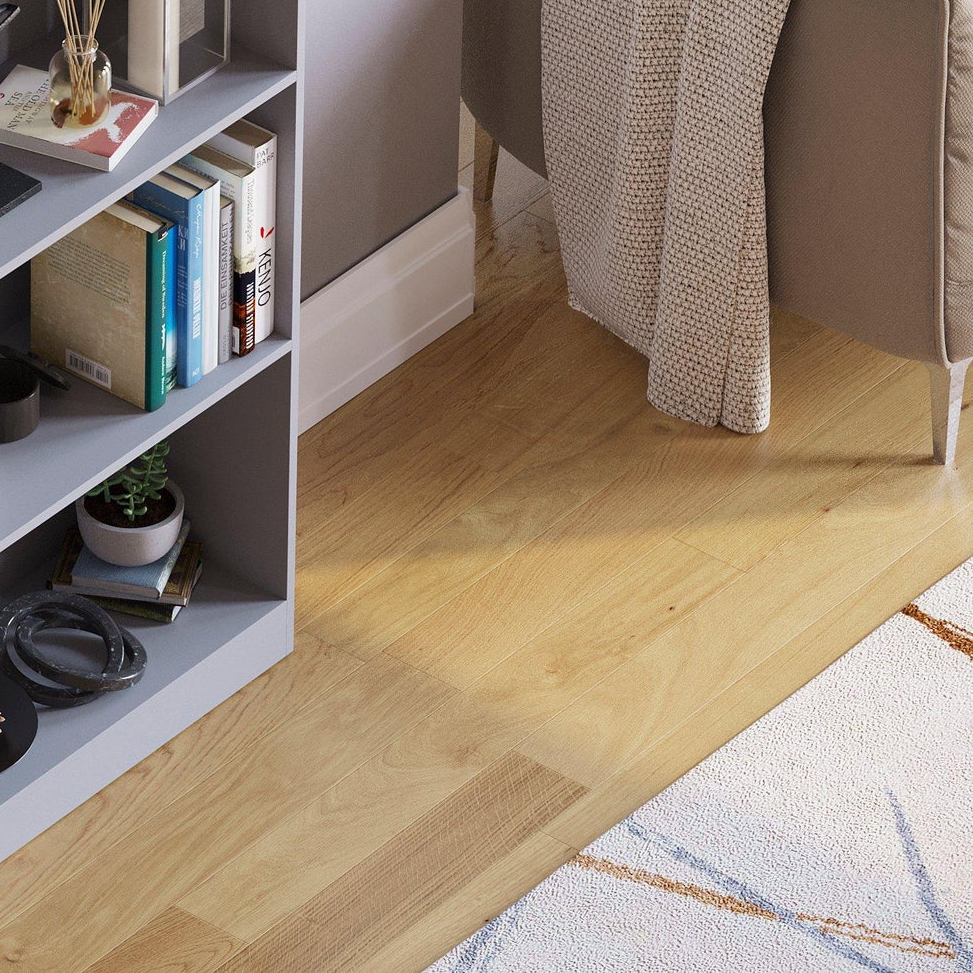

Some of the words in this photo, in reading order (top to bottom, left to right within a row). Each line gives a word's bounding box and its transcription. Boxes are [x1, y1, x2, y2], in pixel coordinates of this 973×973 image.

[5, 91, 22, 105] SEA
[23, 94, 40, 111] OLD
[7, 111, 25, 130] MAN
[257, 147, 269, 159] PAT
[258, 248, 272, 307] KENJO
